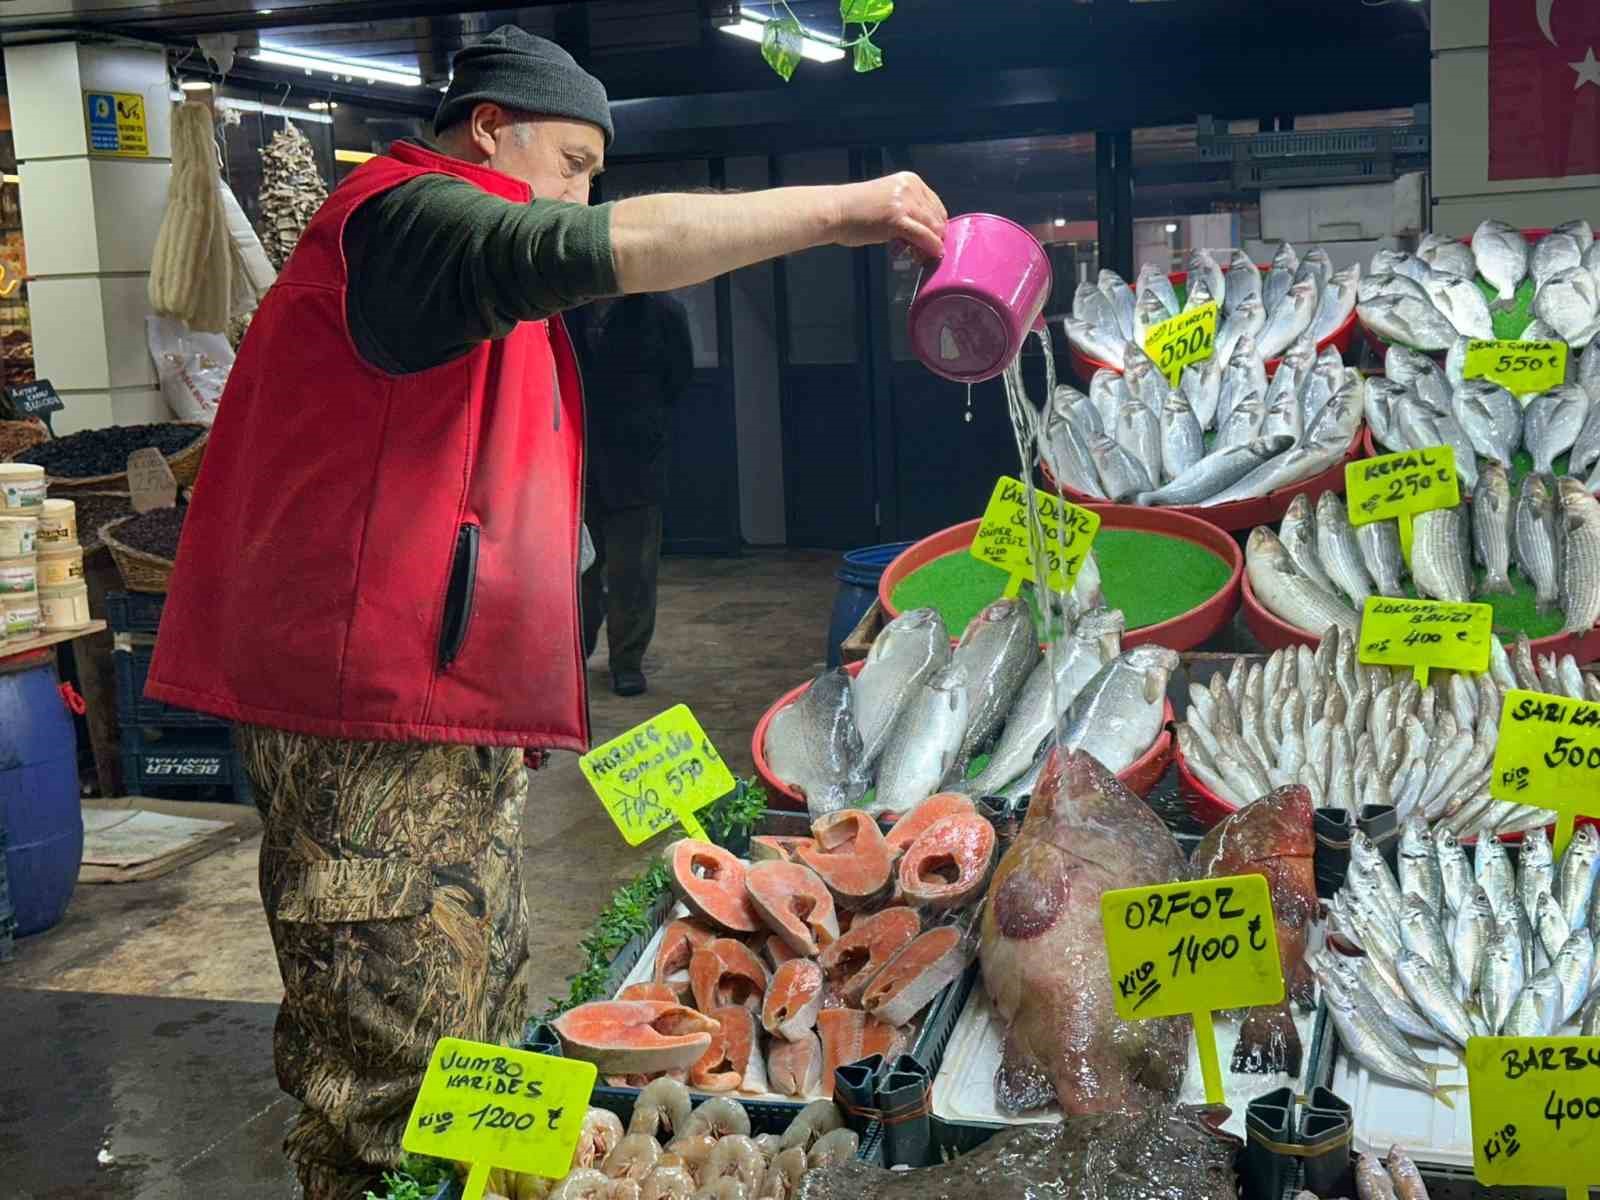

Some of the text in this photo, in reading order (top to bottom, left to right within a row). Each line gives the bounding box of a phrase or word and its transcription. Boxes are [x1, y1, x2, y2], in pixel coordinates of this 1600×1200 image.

[1161, 326, 1204, 368] 550
[1495, 355, 1543, 372] 550
[1365, 452, 1436, 481] KEFAL
[1403, 629, 1442, 647] 400
[1544, 736, 1600, 769] 500
[145, 764, 220, 775] BESLER
[1168, 934, 1240, 977] 1400
[440, 1051, 524, 1078] JUMBO
[468, 1103, 535, 1131] 1200
[1544, 1089, 1600, 1131] 400
